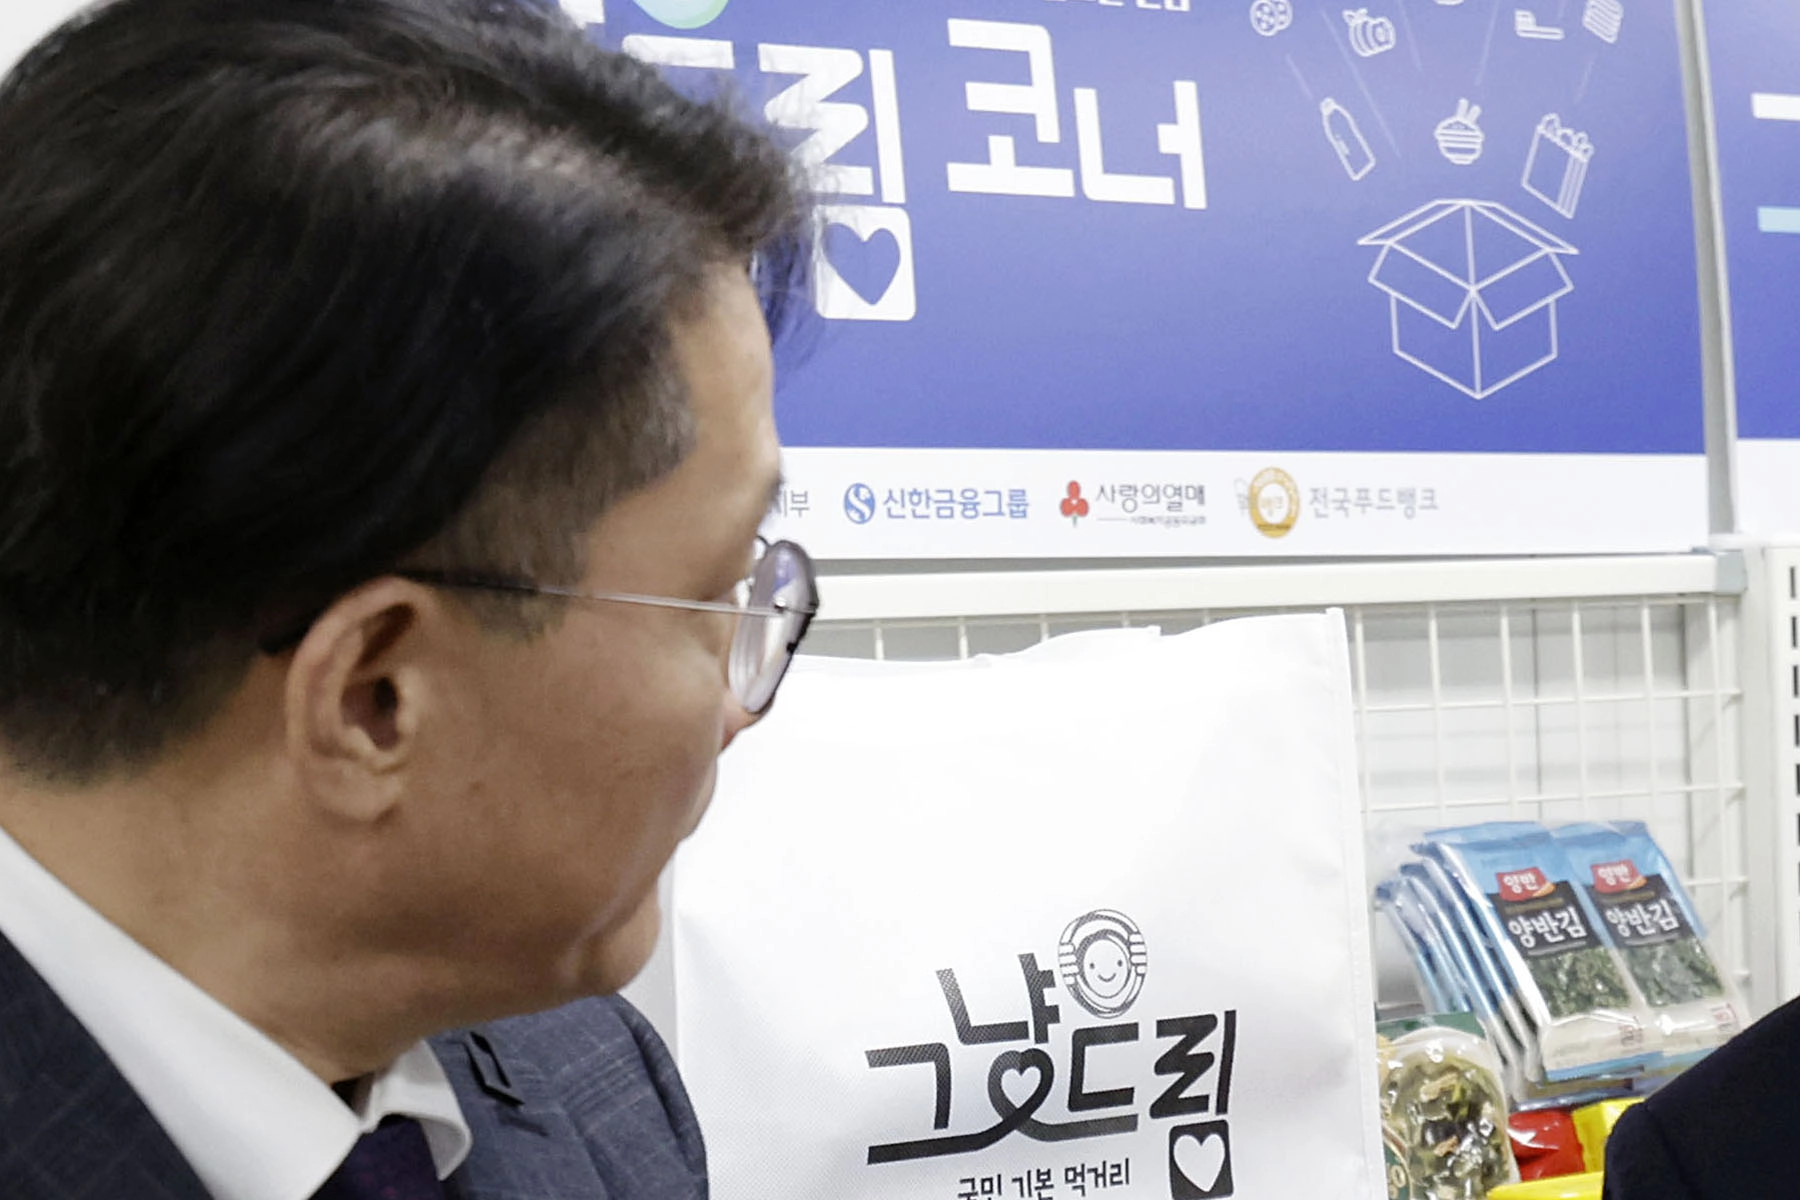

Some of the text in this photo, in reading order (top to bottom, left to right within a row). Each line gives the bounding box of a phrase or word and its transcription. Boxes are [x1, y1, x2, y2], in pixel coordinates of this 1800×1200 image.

[947, 18, 1207, 209] 코너
[883, 488, 1030, 520] 신한금융그룹
[1096, 483, 1206, 514] 사랑의열매
[1308, 486, 1440, 521] 전국푸드뱅크
[1503, 871, 1540, 894] 양반
[1508, 899, 1680, 949] 양반김 양반김
[1063, 1157, 1130, 1198] 먹거리
